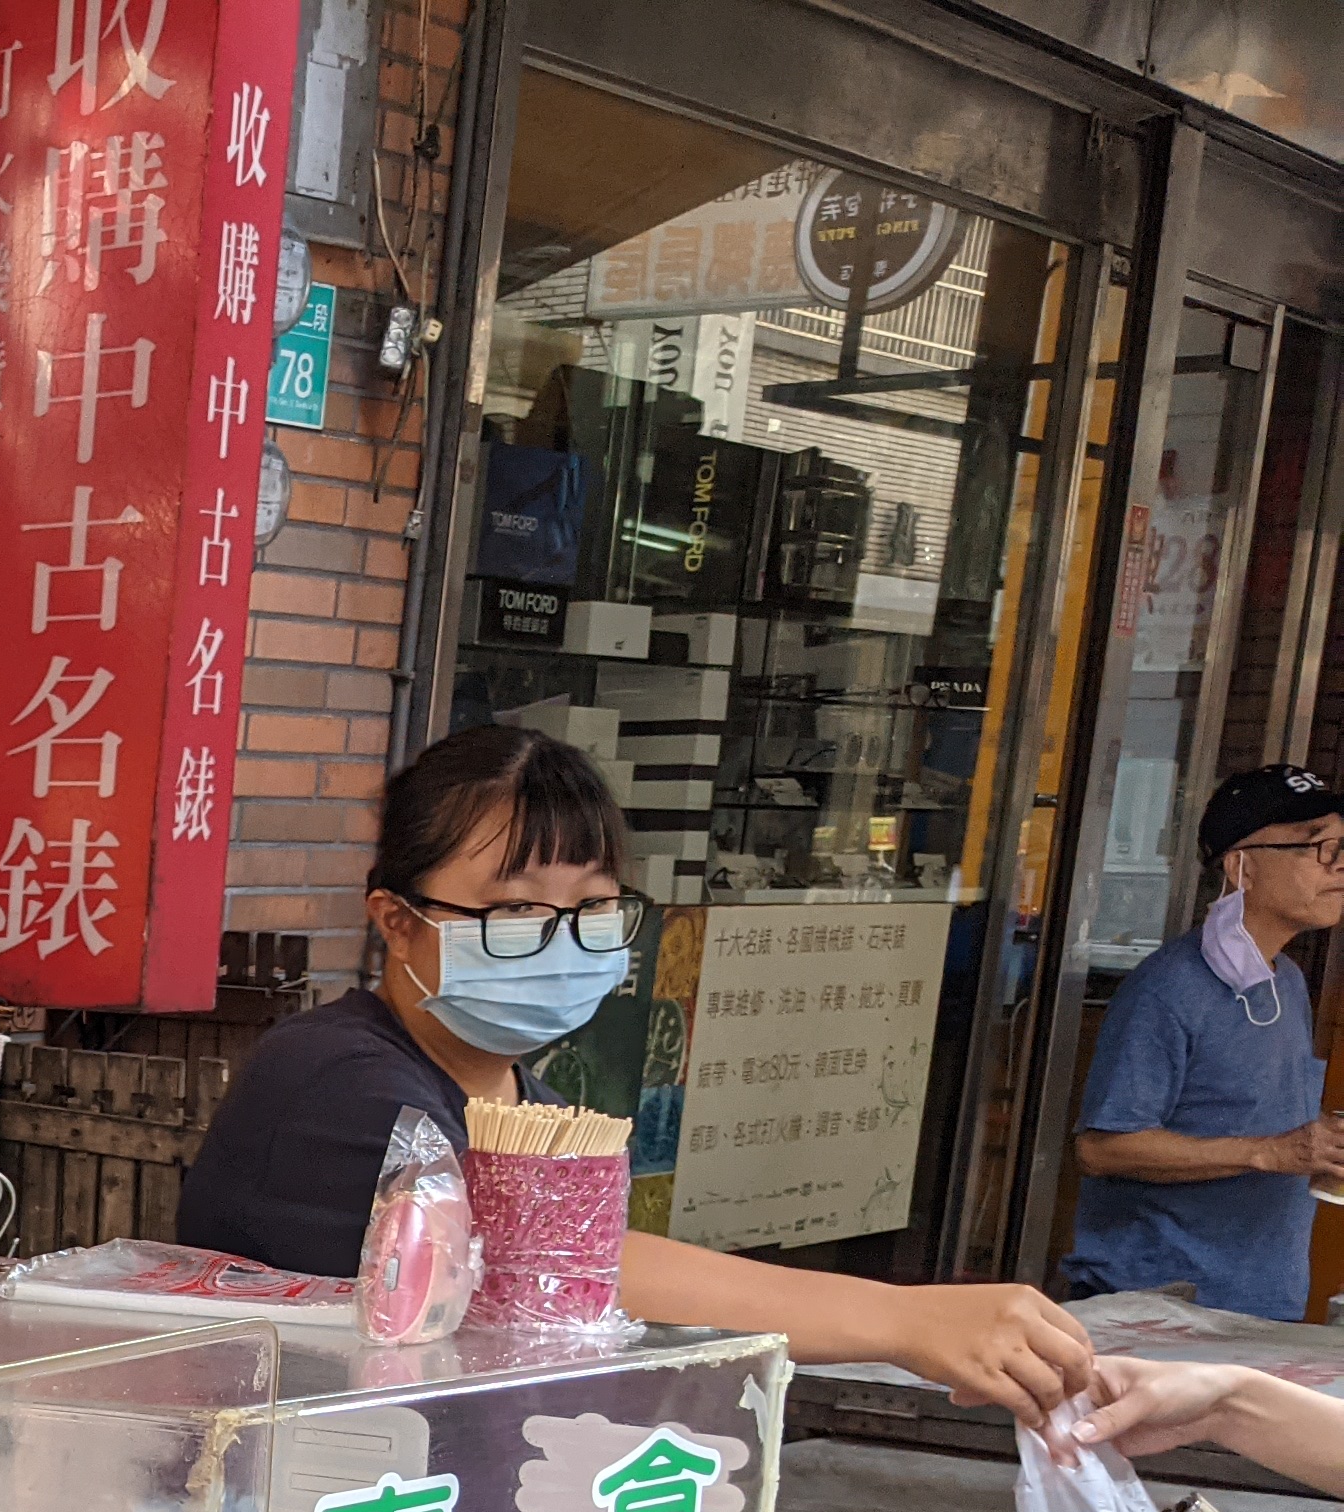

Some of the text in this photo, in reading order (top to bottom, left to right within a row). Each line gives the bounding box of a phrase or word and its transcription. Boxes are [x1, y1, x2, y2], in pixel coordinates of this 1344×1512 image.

[278, 348, 314, 399] 78
[171, 80, 272, 843] 收購中古名錶
[683, 449, 717, 573] TOM FORD
[498, 588, 559, 615] TOM FORD
